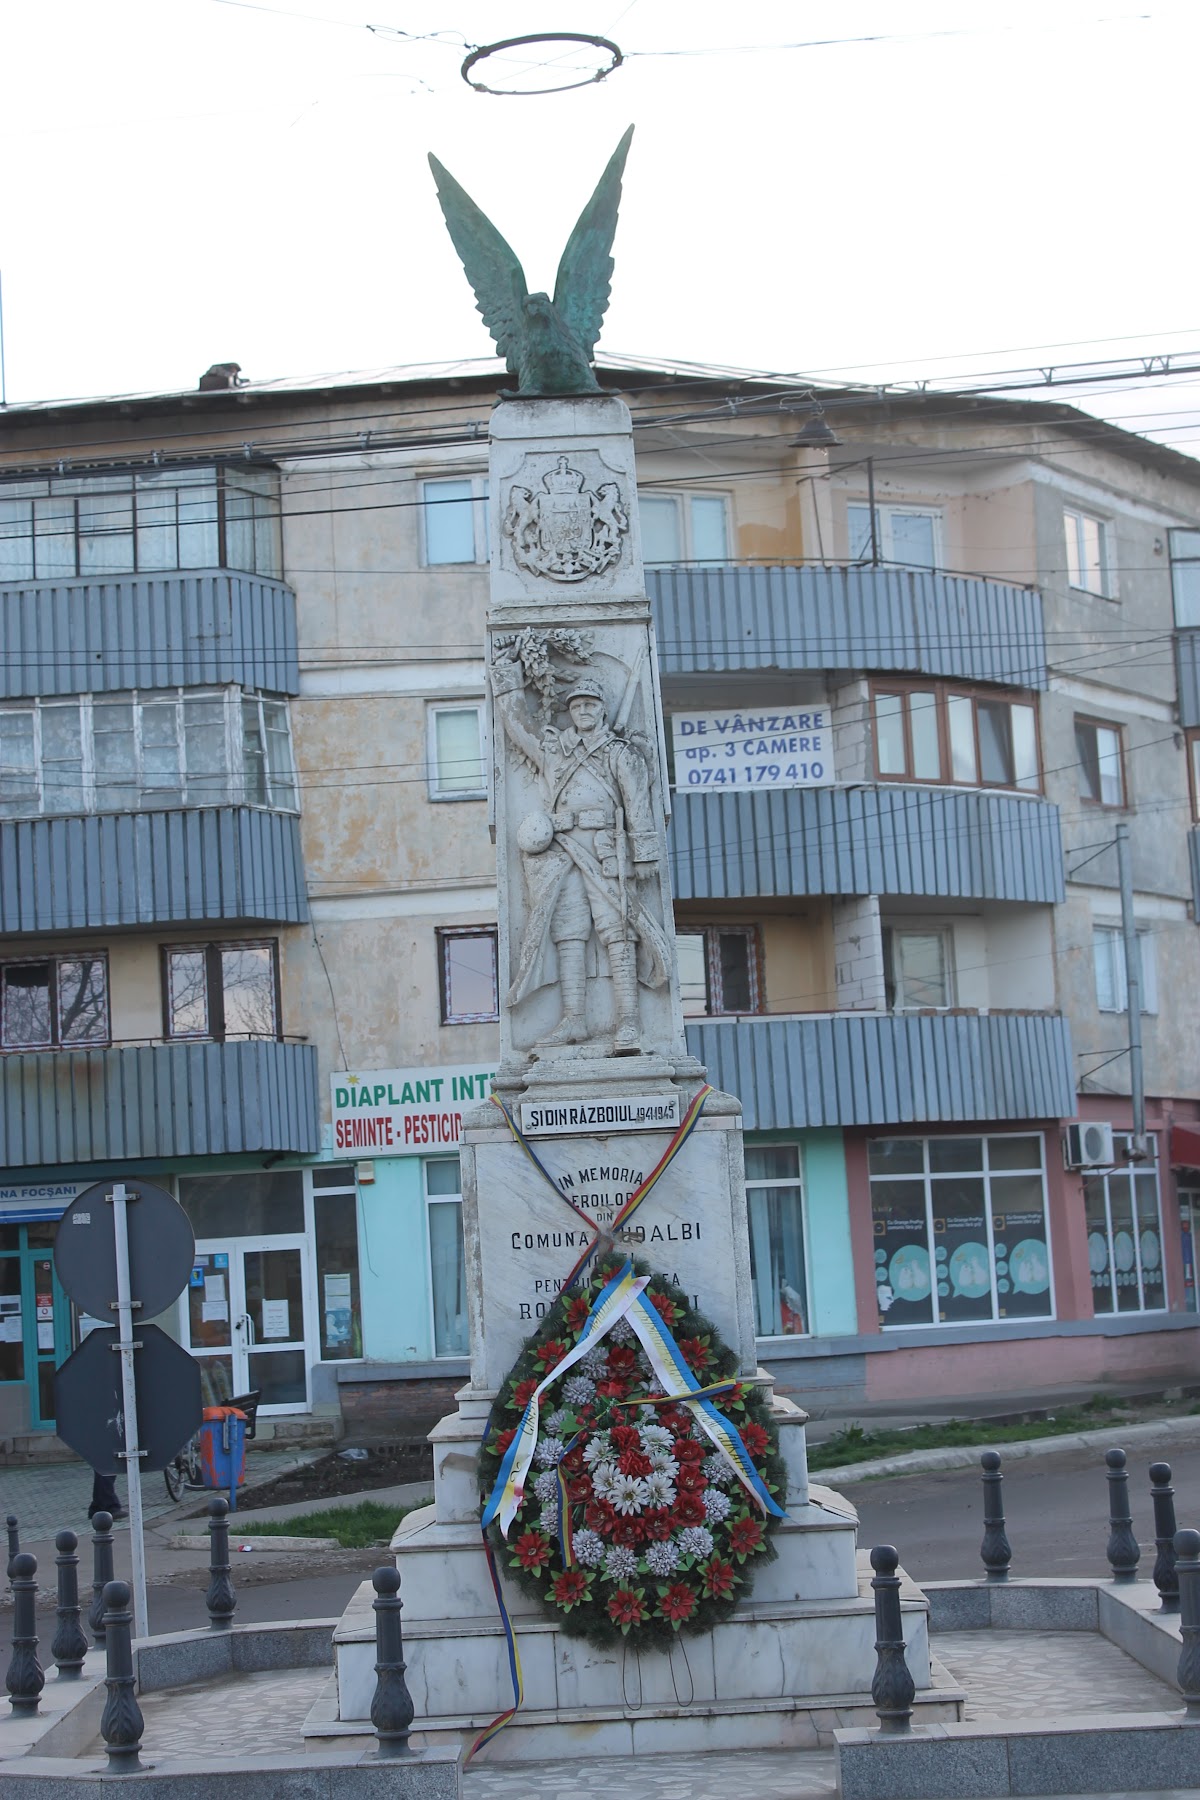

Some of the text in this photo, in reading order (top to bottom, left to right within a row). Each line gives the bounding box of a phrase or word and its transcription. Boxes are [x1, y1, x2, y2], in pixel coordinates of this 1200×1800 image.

[681, 713, 823, 736] DE VÂNZARE
[685, 736, 821, 763] ap. 3 CAMERE
[688, 762, 824, 785] 0741 179 410
[335, 1078, 444, 1108] DIAPLANT
[558, 1166, 643, 1191] IN MEMORIA
[597, 1212, 613, 1222] DIN
[511, 1231, 590, 1250] COMUNA
